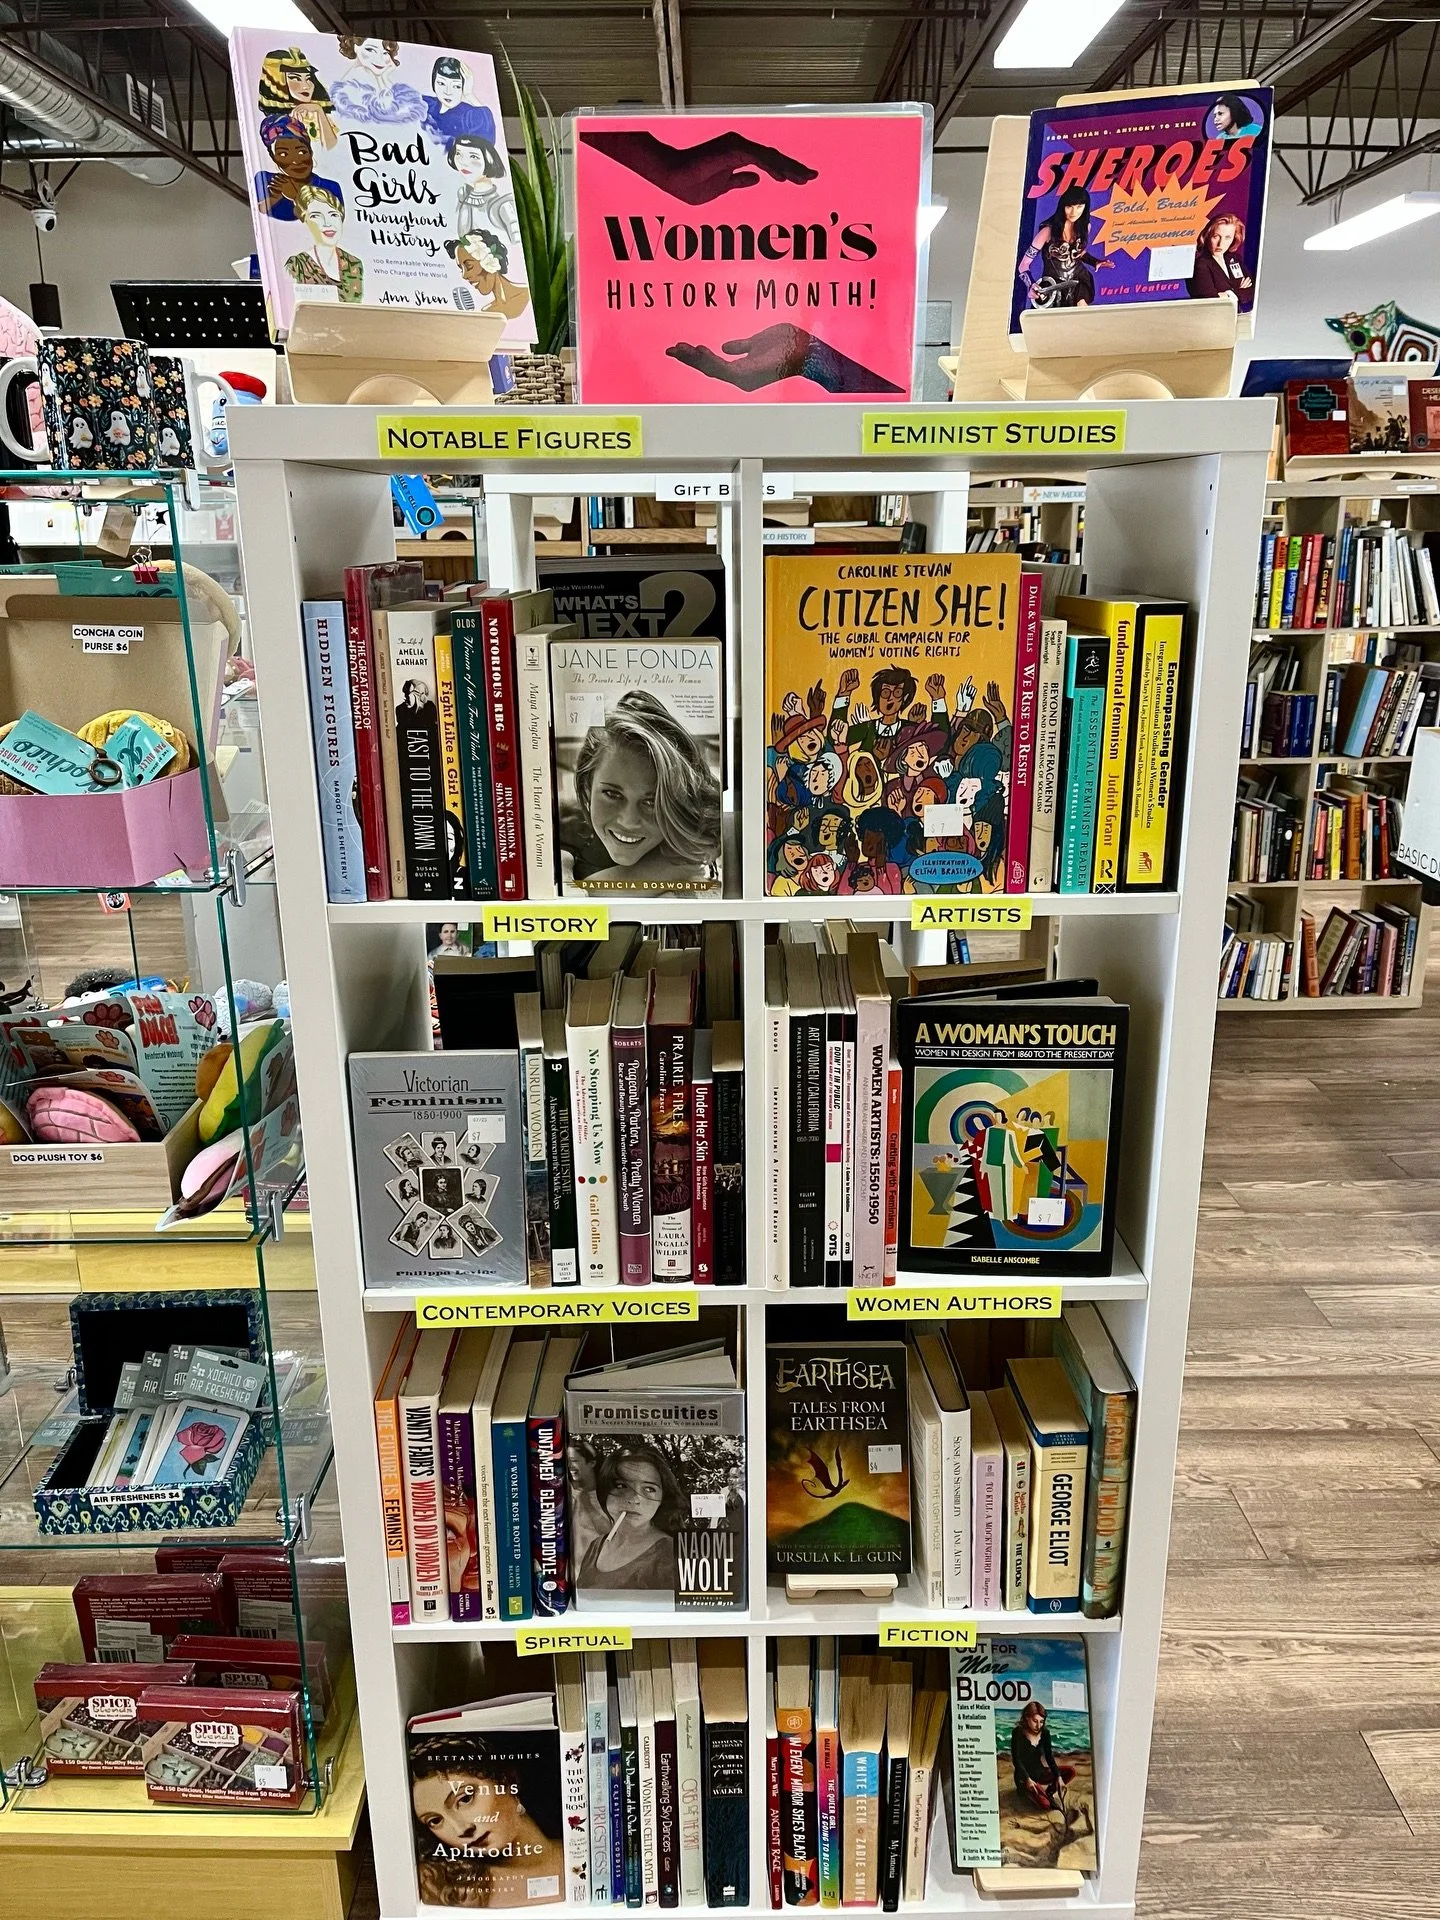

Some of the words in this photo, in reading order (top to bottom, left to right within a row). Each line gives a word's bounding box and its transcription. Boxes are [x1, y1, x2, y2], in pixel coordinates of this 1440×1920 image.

[1046, 133, 1069, 142] FROM
[1072, 130, 1100, 139] SUSAN
[1116, 125, 1156, 135] ANTHONY
[1174, 121, 1197, 129] XENA
[340, 131, 430, 166] Bad
[1027, 136, 1255, 199] SHEROES
[353, 167, 440, 207] Girls
[1113, 202, 1149, 214] Bold,
[1157, 196, 1198, 210] Brash
[354, 208, 447, 232] Throughout
[371, 229, 440, 256] History
[604, 212, 878, 261] Women's
[1108, 228, 1195, 244] Superwomen
[386, 259, 421, 268] Remarkable
[423, 261, 445, 269] Women
[389, 269, 417, 279] Changed
[379, 290, 409, 304] Ann
[414, 289, 448, 305] Shen
[608, 279, 738, 310] HISTORY
[755, 279, 876, 310] MONTH!
[387, 428, 509, 449] NOTABLE
[517, 428, 632, 449] FIGURES
[873, 424, 998, 444] FEMINIST
[1005, 423, 1117, 443] STUDIES
[674, 484, 711, 496] GIFT
[838, 563, 899, 579] CAROLINE
[904, 562, 952, 579] STEVAN
[554, 596, 638, 611] WHAT'S
[799, 586, 921, 631] CITIZEN
[930, 582, 1006, 631] SHE!
[74, 628, 115, 637] CONCHA
[118, 629, 143, 638] COIN
[456, 619, 476, 629] OLDS
[84, 642, 113, 651] PURSE
[116, 643, 128, 651] $6
[818, 633, 841, 644] THE
[846, 632, 880, 644] GLOBAL
[885, 632, 943, 644] CAMPAIGN
[948, 631, 970, 643] FOR
[317, 618, 333, 688] HIDDEN
[488, 617, 504, 699] NOTORIOUS
[558, 648, 617, 669] JANE
[627, 649, 714, 669] FONDA
[829, 645, 874, 658] WOMEN'S
[880, 646, 920, 657] VOTING
[925, 646, 961, 658] RIGHTS
[396, 657, 428, 666] EARHART
[1048, 682, 1058, 727] BEYOND
[1159, 662, 1177, 757] Encompassing
[494, 703, 505, 732] RBG
[569, 712, 579, 724] $7
[323, 694, 340, 767] FIGURES
[1047, 730, 1056, 750] THE
[1044, 753, 1055, 814] FRAGMENTS
[1157, 761, 1171, 808] Gender
[1399, 843, 1428, 870] BASIC
[582, 881, 637, 890] PATRICIA
[643, 881, 707, 890] BOSWORTH
[920, 906, 1022, 923] ARTISTS
[493, 916, 599, 934] HISTORY
[915, 1023, 931, 1044] A
[934, 1024, 1042, 1045] WOMAN'S
[1043, 1024, 1117, 1046] TOUCH
[915, 1049, 948, 1057] WOMEN
[951, 1049, 959, 1057] IN
[962, 1050, 990, 1058] DESIGN
[993, 1050, 1015, 1058] FROM
[1017, 1050, 1033, 1058] 1860
[1033, 1050, 1046, 1058] TO
[1046, 1050, 1062, 1058] THE
[1063, 1050, 1098, 1059] PRESENT
[1098, 1050, 1114, 1059] DAY
[402, 1070, 469, 1093] Victorian
[369, 1095, 504, 1108] Feminism
[413, 1111, 463, 1120] 1850-1900
[472, 1132, 481, 1141] $7
[13, 1154, 35, 1162] DOG
[37, 1154, 66, 1162] PLUSH
[68, 1153, 88, 1161] TOY
[90, 1153, 103, 1161] $6
[655, 1240, 689, 1248] INGALLS
[656, 1249, 689, 1257] WILDER
[828, 1234, 837, 1257] OTIS
[971, 1256, 1002, 1264] ISABELLE
[1003, 1256, 1040, 1264] ANSCOMBE
[422, 1303, 602, 1321] CONTEMPORARY
[612, 1300, 691, 1317] VOICES
[855, 1296, 940, 1312] WOMEN
[946, 1295, 1053, 1311] AUTHORS
[206, 1368, 242, 1387] XOCHICO
[775, 1357, 896, 1394] EARTHSEA
[190, 1378, 203, 1391] AIR
[205, 1384, 250, 1404] FRESHENER
[583, 1404, 719, 1420] Promiscuities
[789, 1401, 837, 1414] TALES
[842, 1401, 885, 1413] FROM
[792, 1416, 888, 1431] EARTHSEA
[510, 1454, 517, 1463] IF
[538, 1428, 554, 1481] UNTAMED
[510, 1466, 519, 1498] WOMEN
[110, 1493, 167, 1502] FRESHENERS
[1050, 1473, 1073, 1527] GEORGE
[540, 1489, 555, 1538] GLENNON
[695, 1508, 703, 1516] $7
[513, 1525, 521, 1560] ROOTED
[678, 1532, 733, 1560] NAOMI
[1049, 1531, 1070, 1567] ELIOT
[541, 1541, 557, 1576] DOYLE
[678, 1558, 734, 1591] WOLF
[524, 1634, 625, 1649] SPIRTUAL
[887, 1628, 968, 1642] FICTION
[958, 1655, 1010, 1674] More
[957, 1676, 1032, 1701] BLOOD
[92, 1696, 132, 1708] SPICE
[194, 1724, 235, 1735] SPICE
[856, 1756, 867, 1789] WHITE
[177, 1786, 203, 1795] Delicious,
[204, 1788, 226, 1796] Healthy
[448, 1780, 519, 1795] Venus
[473, 1812, 500, 1823] and
[856, 1794, 867, 1824] TEETH
[432, 1843, 543, 1861] Aphrodite
